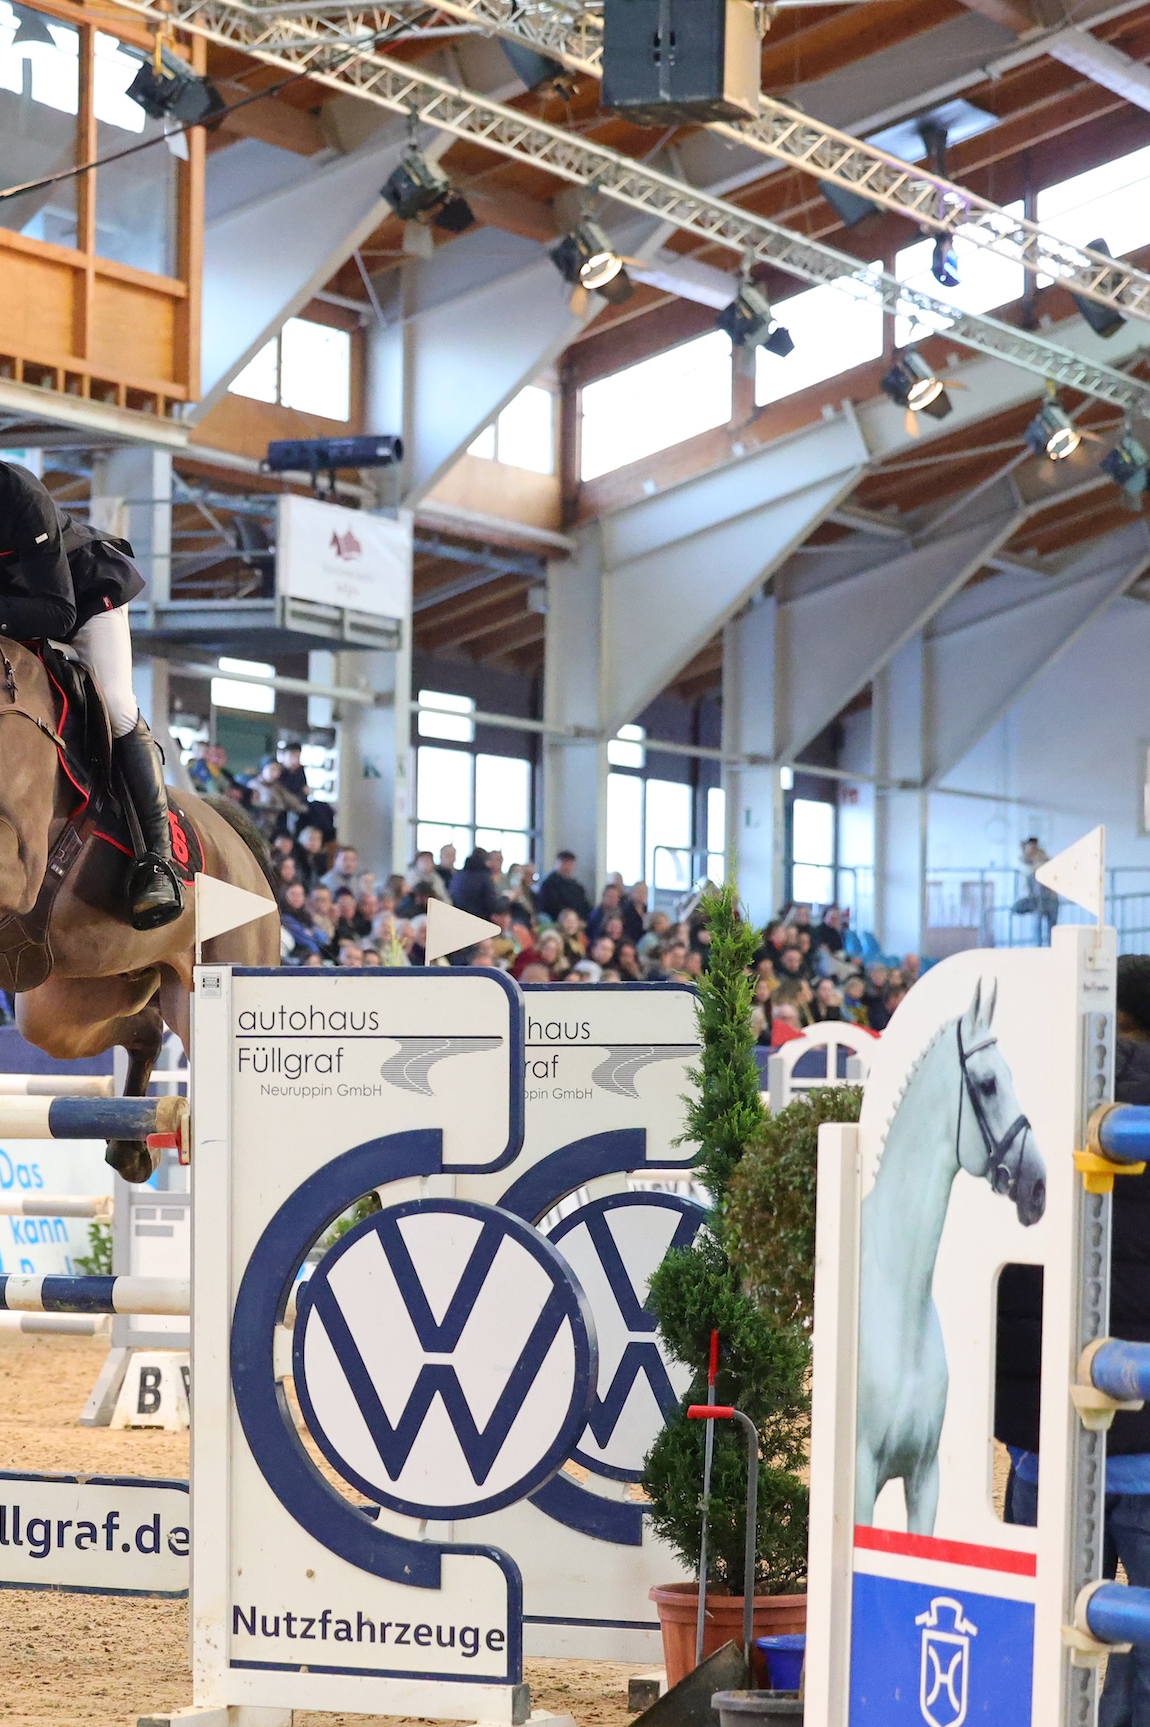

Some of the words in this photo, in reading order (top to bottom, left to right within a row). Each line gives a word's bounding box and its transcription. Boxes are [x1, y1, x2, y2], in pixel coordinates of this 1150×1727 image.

[238, 1004, 380, 1031] autohaus
[528, 1016, 591, 1040] haus
[238, 1047, 345, 1080] Füllgraf
[260, 1084, 333, 1099] Neuruppin
[336, 1084, 382, 1097] GmbH
[552, 1087, 594, 1100] GmbH
[9, 1216, 70, 1246] kann
[136, 1366, 163, 1415] B
[232, 1605, 506, 1657] Nutzfahrzeuge
